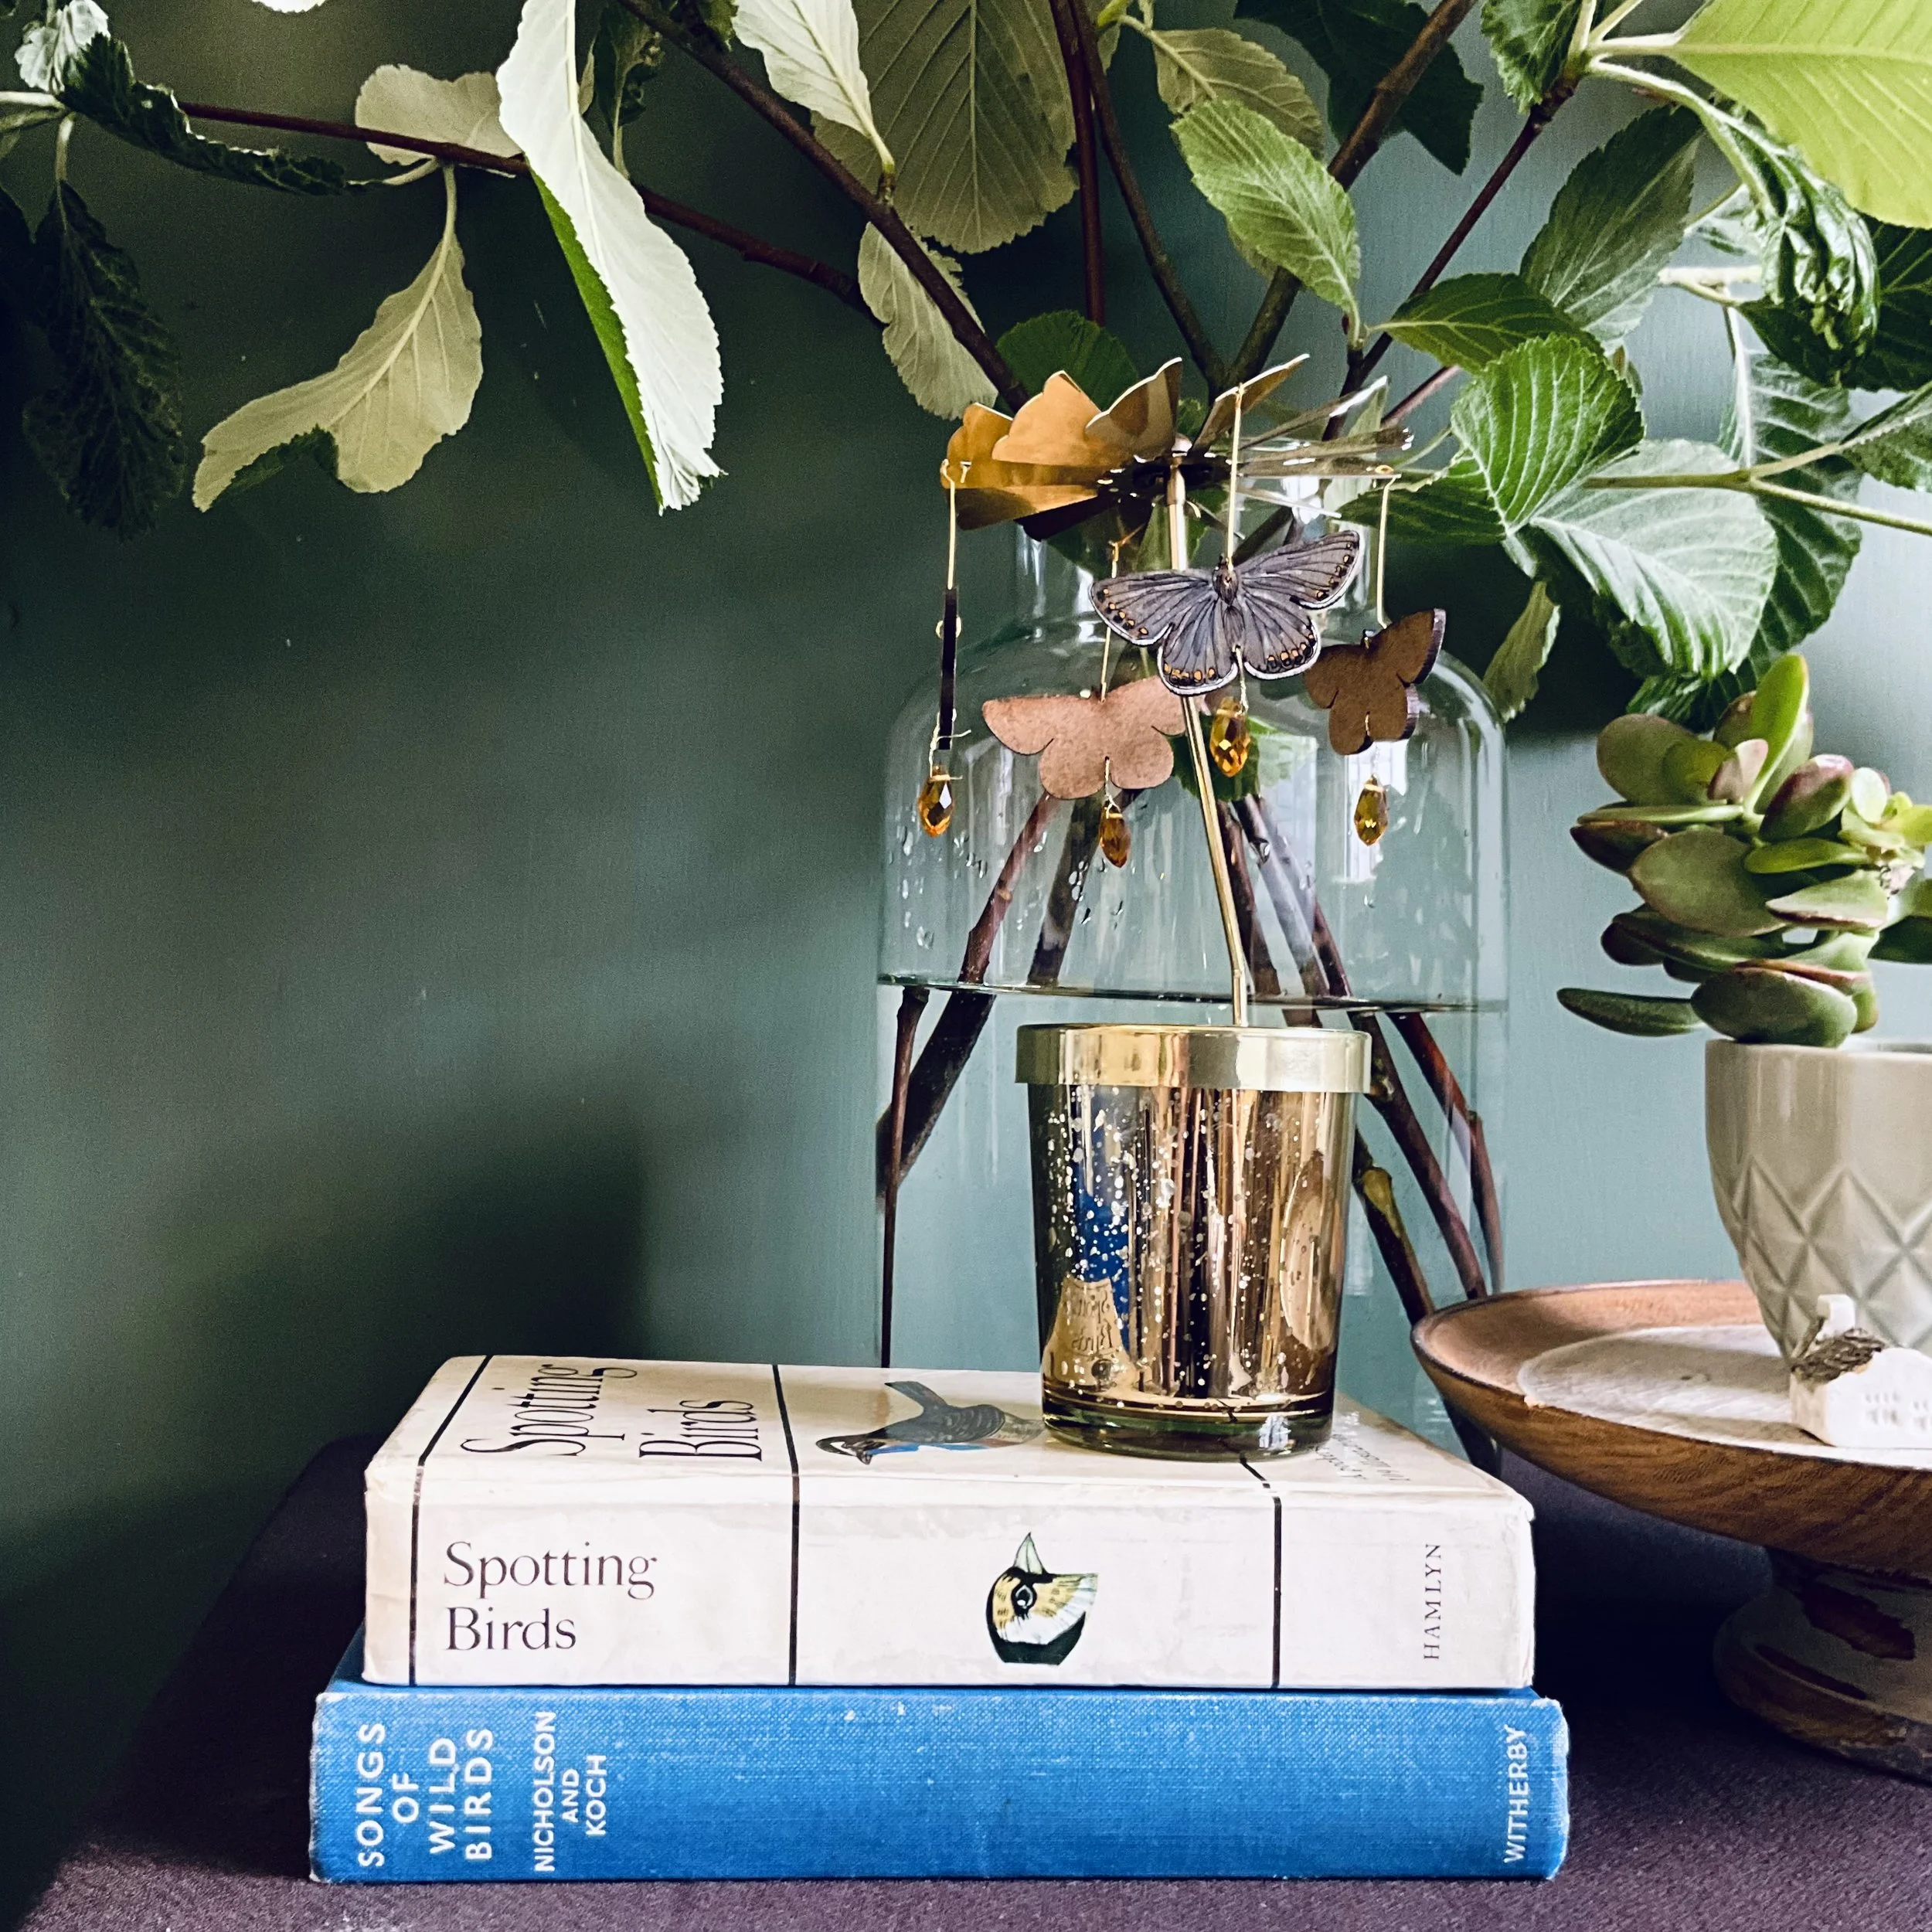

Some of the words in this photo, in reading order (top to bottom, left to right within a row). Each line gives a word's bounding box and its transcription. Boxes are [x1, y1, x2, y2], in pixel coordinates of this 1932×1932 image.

[461, 1364, 638, 1456] Spotting
[639, 1400, 762, 1461] Birds
[443, 1541, 658, 1600] Spotting
[1423, 1543, 1442, 1660] HAMLYN
[445, 1606, 577, 1651] Birds
[355, 1723, 386, 1867] SONGS
[392, 1772, 420, 1824] OF
[429, 1737, 457, 1855] WILD
[464, 1728, 494, 1860] BIRDS
[534, 1710, 556, 1872] NICHOLSON
[561, 1768, 580, 1824] AND
[585, 1754, 607, 1836] KOCH
[1503, 1723, 1529, 1863] WITHERBY
